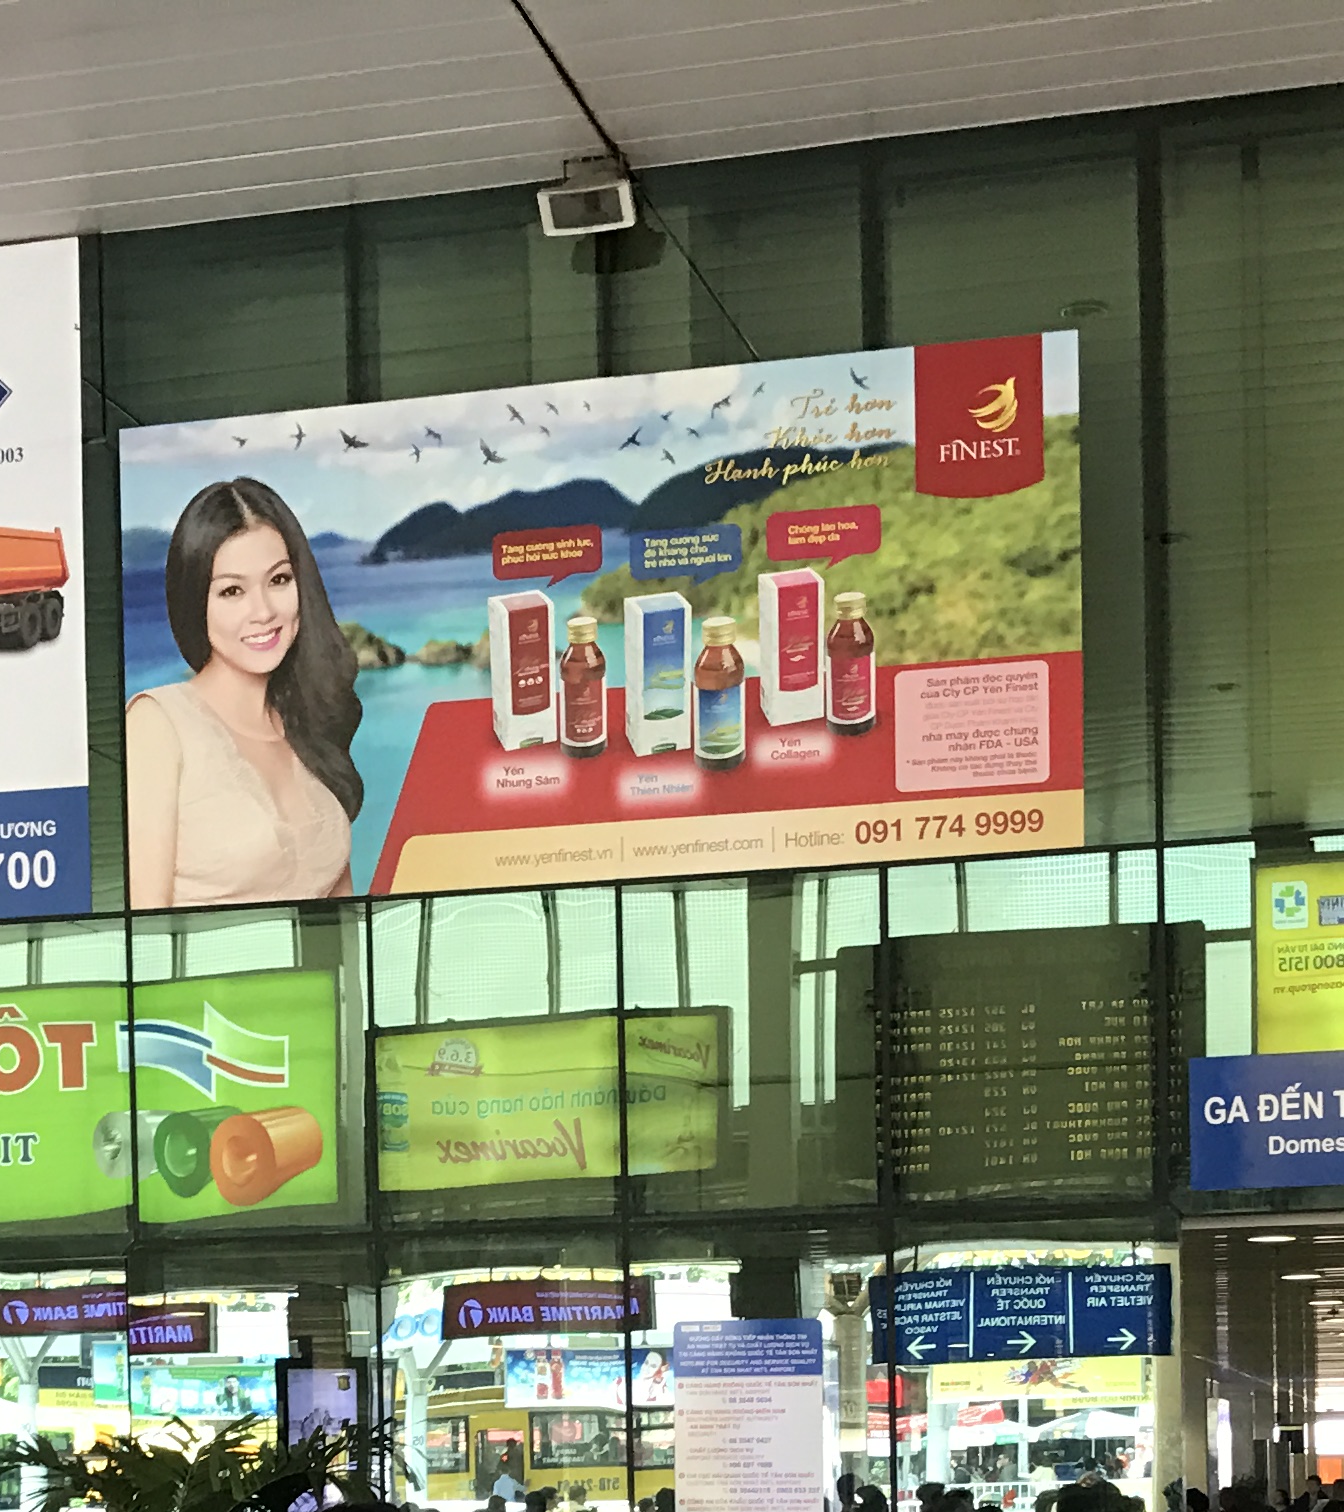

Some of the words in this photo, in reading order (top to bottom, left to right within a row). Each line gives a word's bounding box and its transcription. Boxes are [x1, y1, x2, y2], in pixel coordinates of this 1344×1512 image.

[963, 686, 980, 695] CP
[979, 740, 1003, 750] FDA
[1014, 737, 1039, 747] USA
[771, 748, 820, 761] Collagen
[496, 777, 532, 790] Nhung
[495, 843, 613, 868] www.yenfinest.vn
[633, 834, 763, 859] www.yenfinest.com
[785, 829, 845, 849] Hotline:
[855, 820, 903, 845] 091
[915, 815, 966, 840] 774
[975, 808, 1043, 835] 9999
[1203, 1093, 1250, 1126] GA
[1257, 1083, 1325, 1123] ĐẾN
